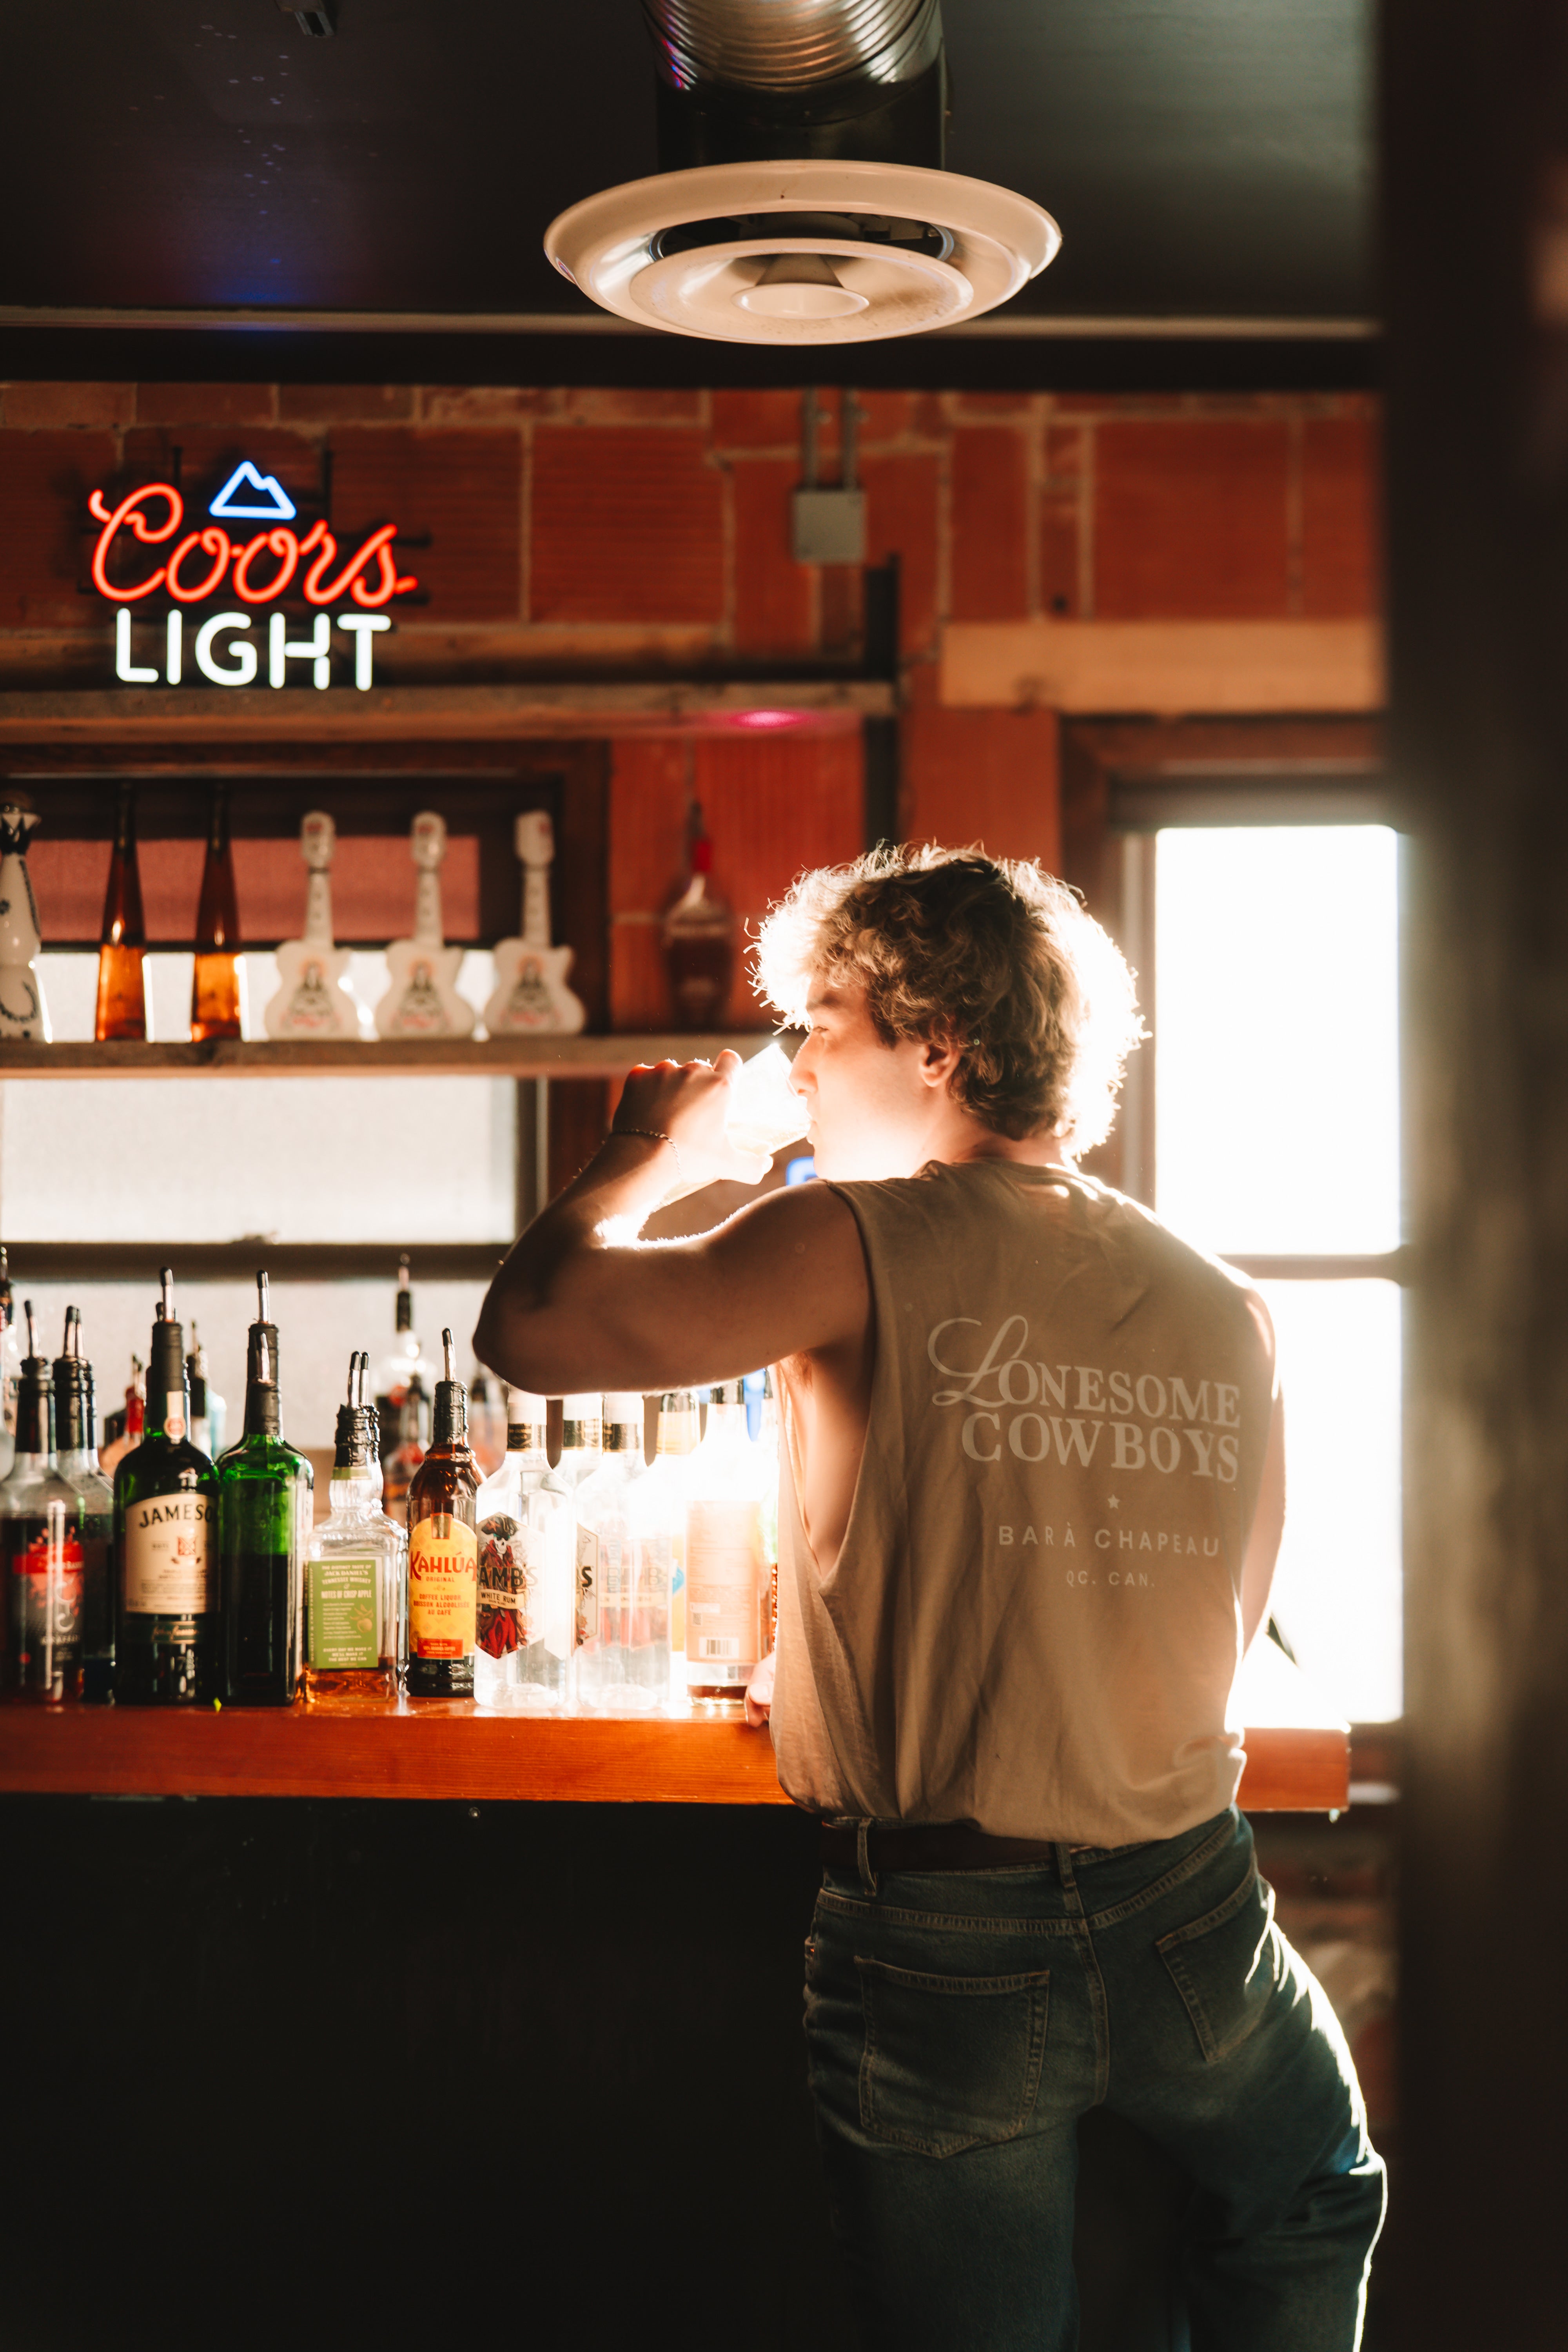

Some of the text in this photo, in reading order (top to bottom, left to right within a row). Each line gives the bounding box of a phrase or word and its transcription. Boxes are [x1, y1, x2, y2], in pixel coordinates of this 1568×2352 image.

[88, 482, 417, 608] Coors
[116, 608, 392, 691] LIGHT
[927, 1315, 1241, 1429] LONESOME
[962, 1412, 1240, 1484] COWBOYS
[139, 1504, 213, 1528] JAMESO
[1094, 1529, 1219, 1556] CHAPEAU
[410, 1551, 477, 1582] KAHLÚA
[479, 1563, 538, 1587] AMB'S
[1066, 1570, 1155, 1587] QC. CAN.
[321, 1589, 372, 1599] NOTES OF CRISP APPLE
[481, 1592, 516, 1604] WHITE RUM
